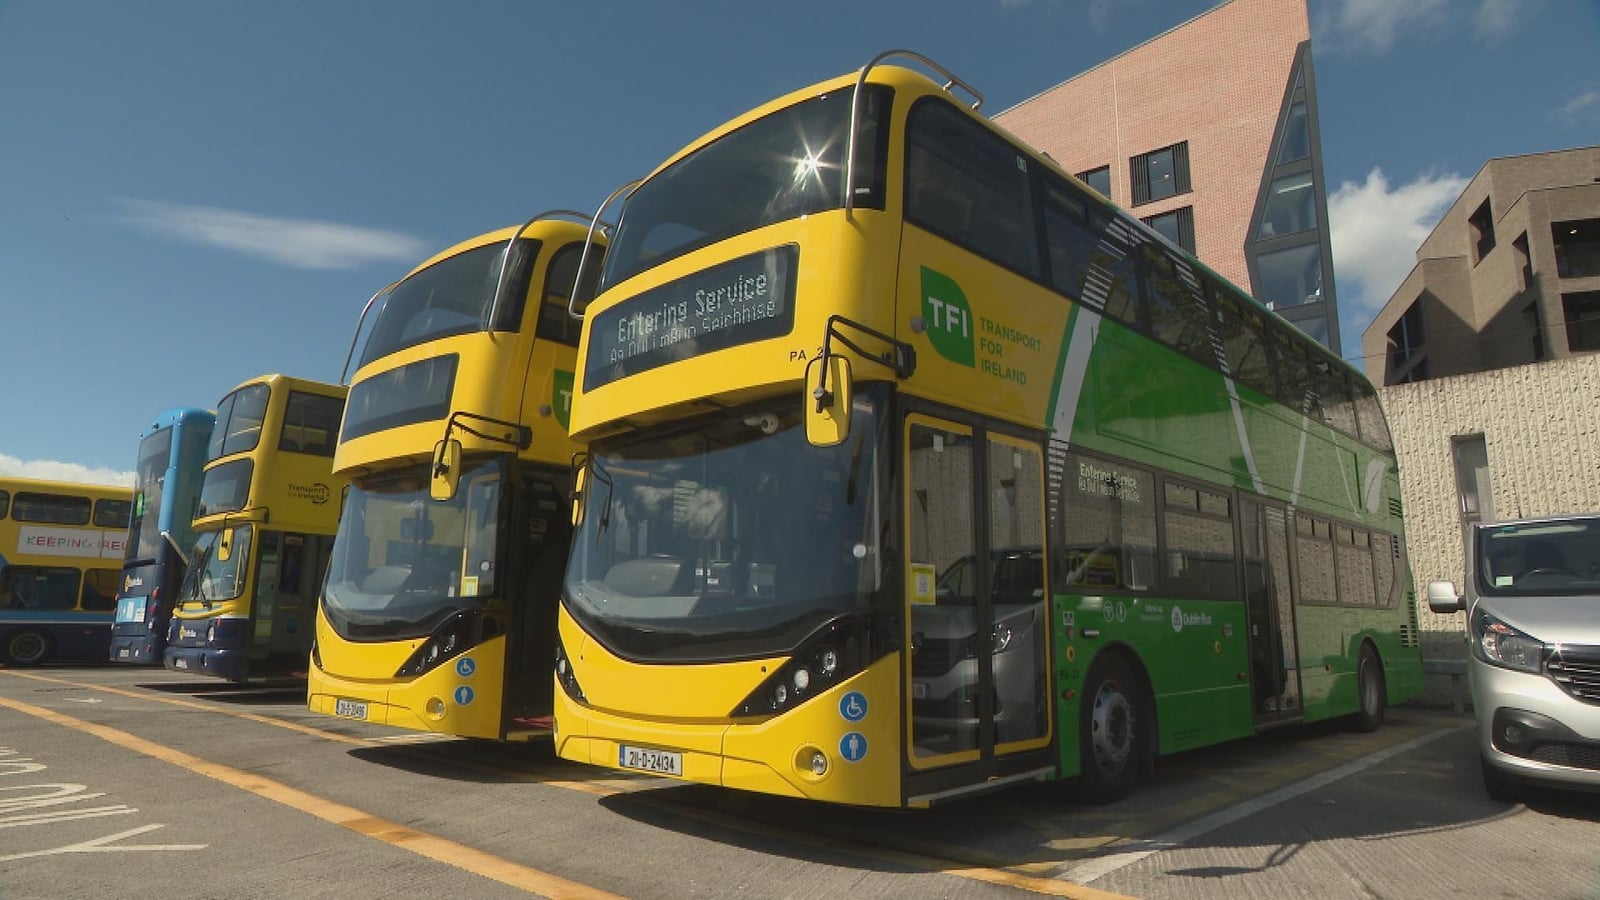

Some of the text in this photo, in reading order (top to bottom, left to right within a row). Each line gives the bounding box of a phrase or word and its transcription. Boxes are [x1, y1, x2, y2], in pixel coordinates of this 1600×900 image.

[618, 274, 767, 344] Entering Service
[928, 296, 968, 338] TFI
[980, 317, 1041, 352] TRANSPORT
[789, 349, 807, 362] PA
[981, 338, 1003, 358] FOR
[981, 358, 1027, 385] IRELAND
[1080, 462, 1112, 482] Entering
[27, 535, 129, 551] KEEPING IREL
[629, 751, 674, 772] 211-D-24134
